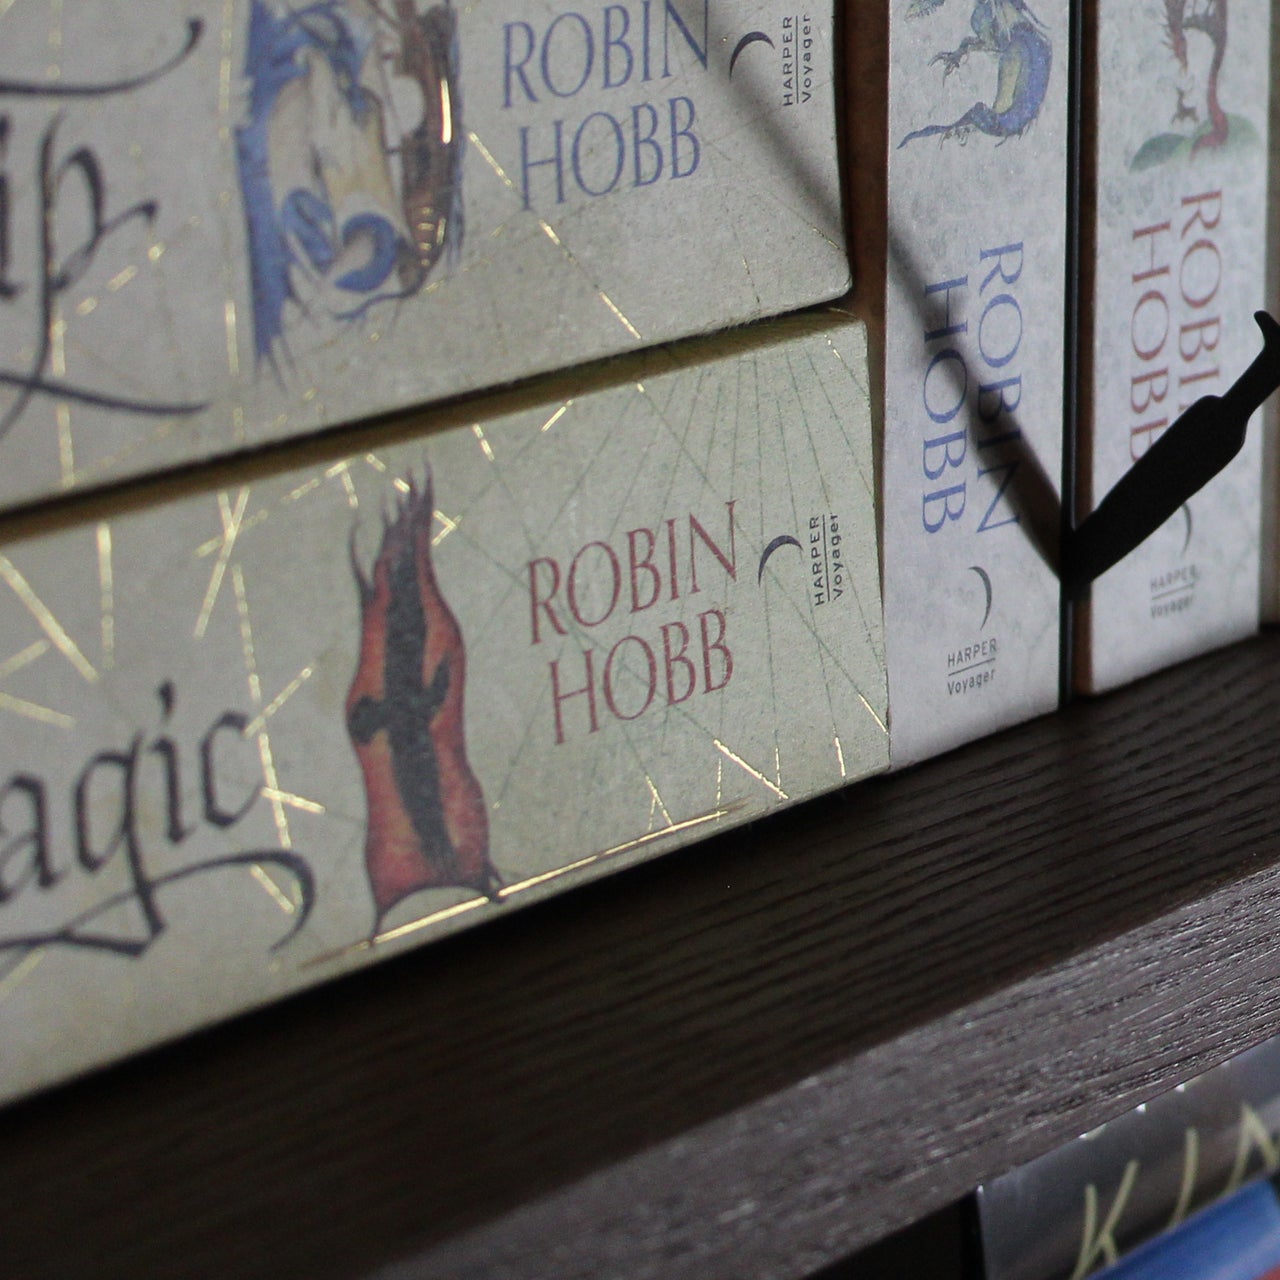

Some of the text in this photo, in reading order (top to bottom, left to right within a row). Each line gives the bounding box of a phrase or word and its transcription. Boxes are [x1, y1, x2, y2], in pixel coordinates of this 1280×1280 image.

[782, 14, 794, 107] HARPER
[801, 12, 815, 106] Voyager
[517, 95, 702, 210] HOBB
[1178, 190, 1223, 412] ROBI
[922, 274, 969, 535] HOBB
[976, 241, 1024, 536] ROBIN
[527, 500, 738, 645] ROBIN
[810, 515, 825, 606] HARPER
[831, 511, 843, 601] Voyager
[548, 608, 735, 746] HOBB
[947, 637, 998, 670] HARPER
[947, 666, 997, 697] Voyager
